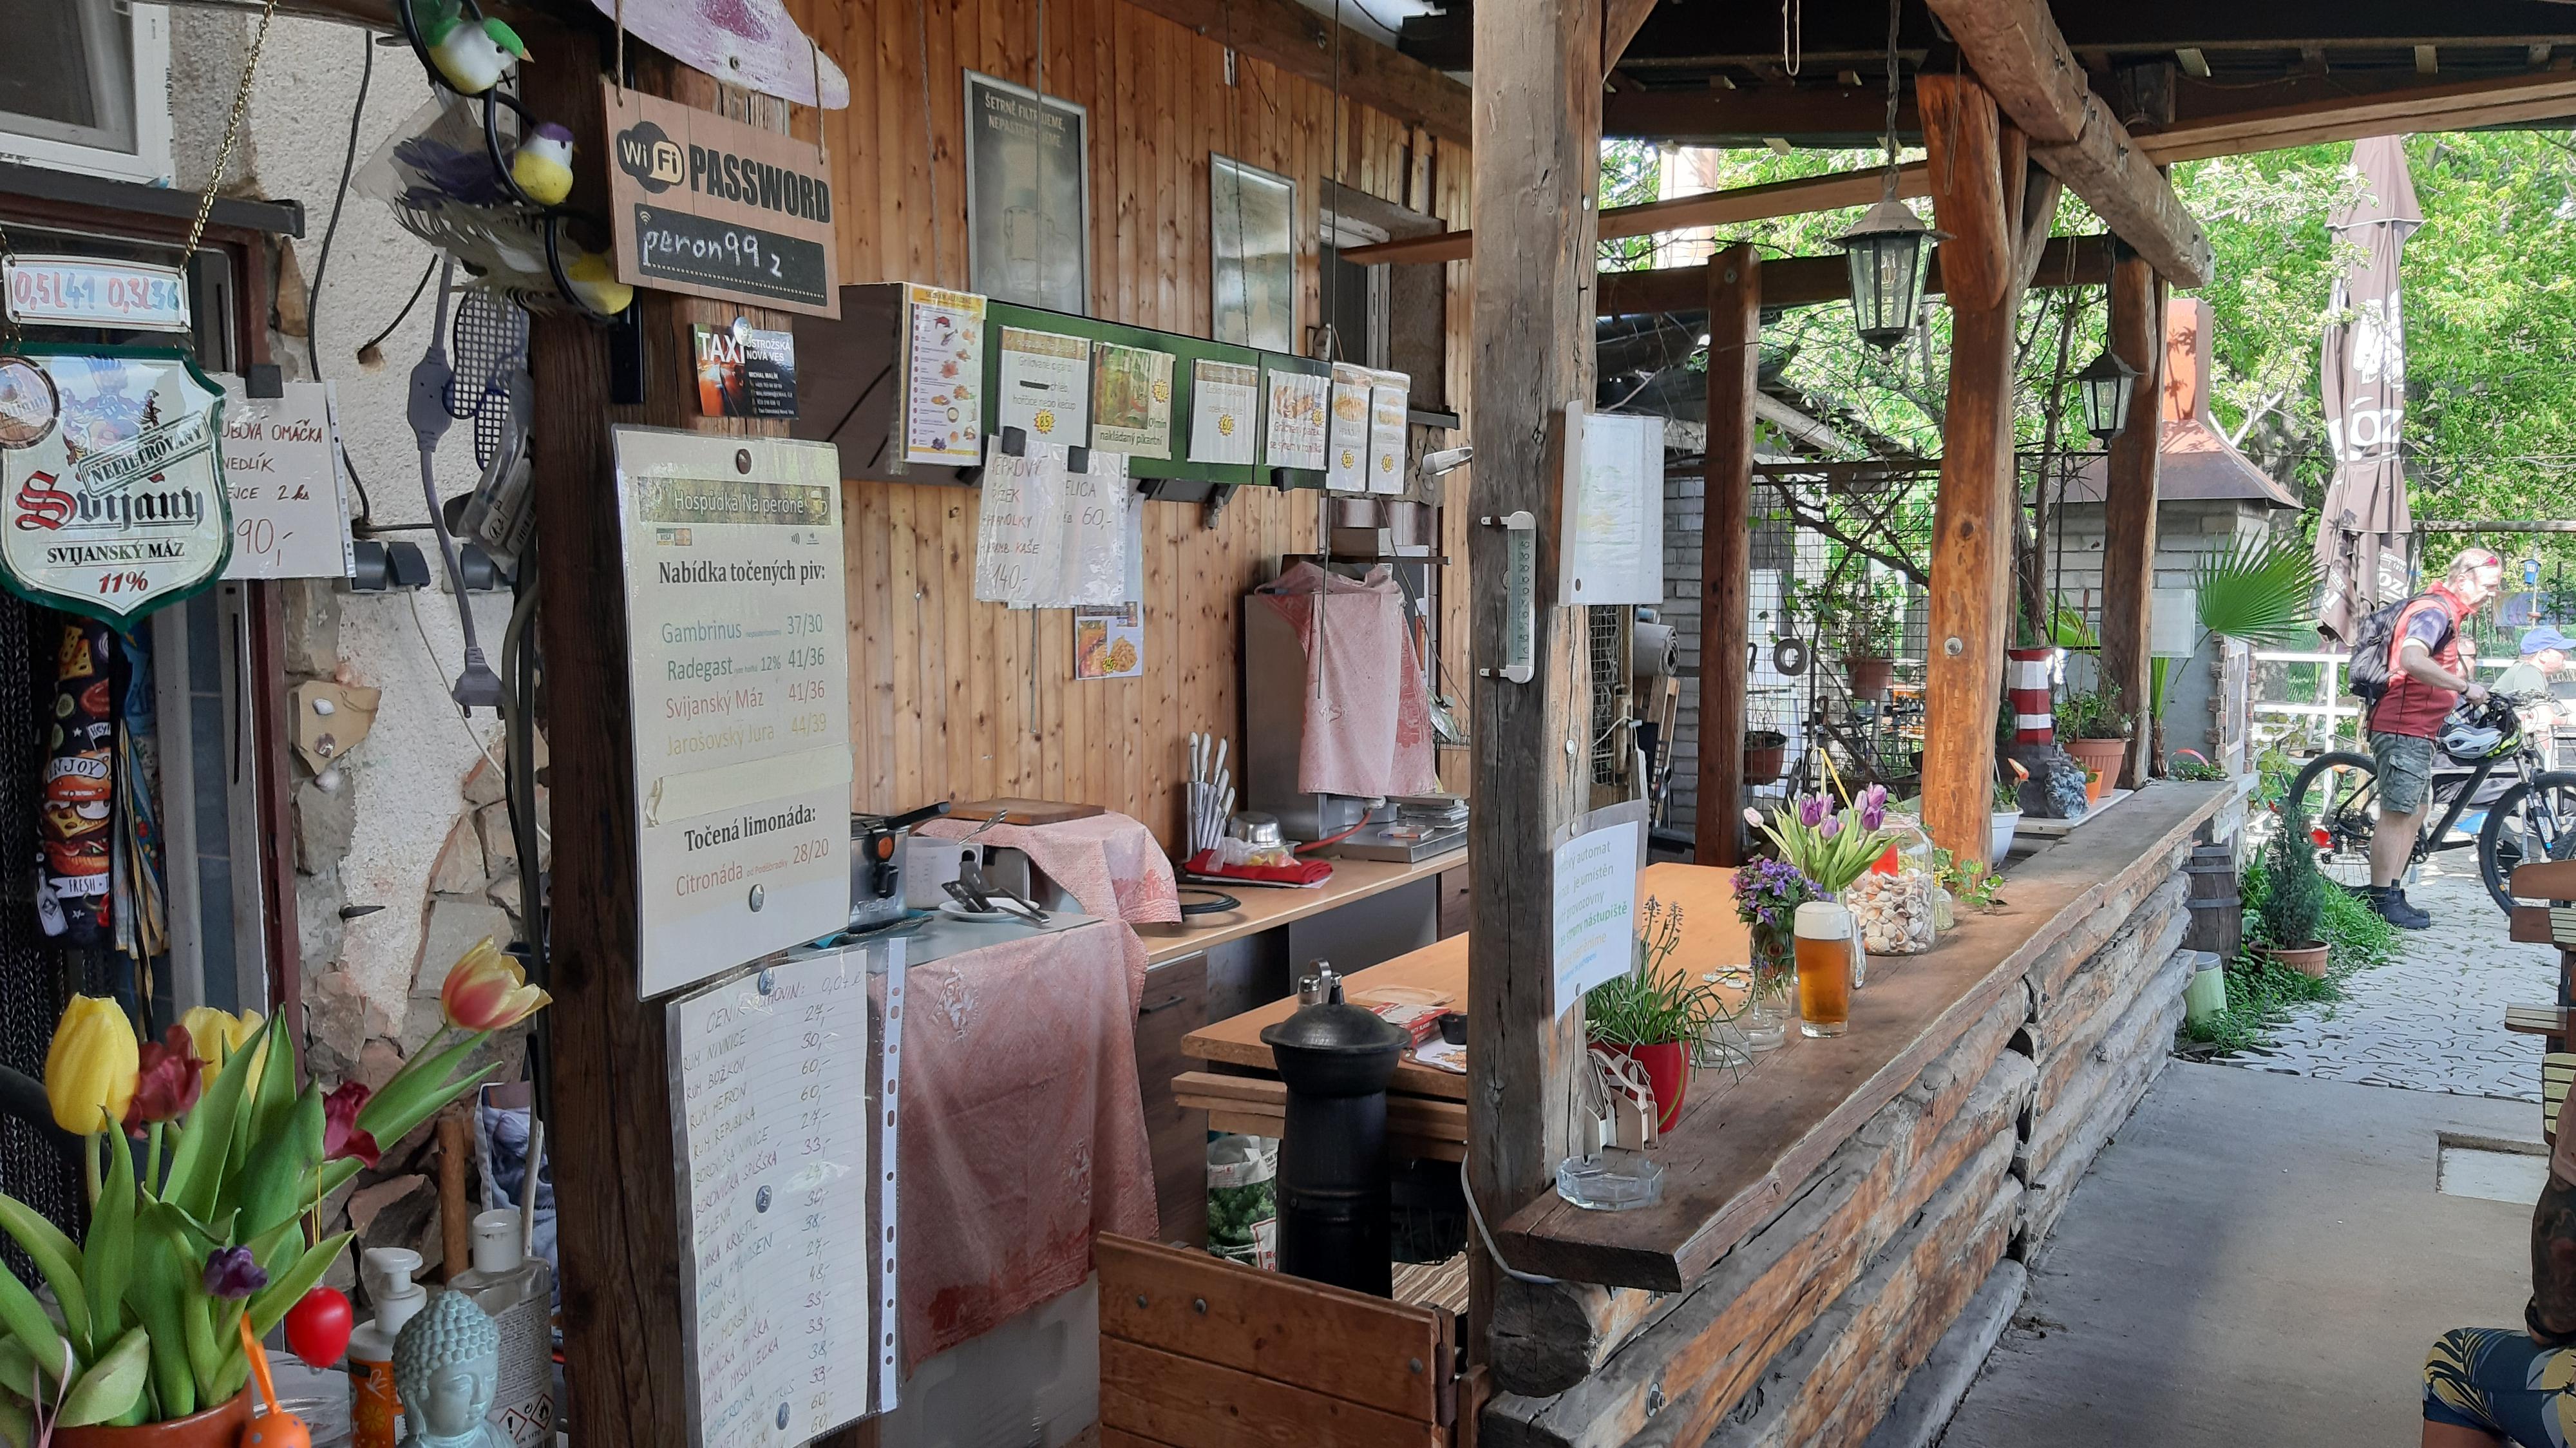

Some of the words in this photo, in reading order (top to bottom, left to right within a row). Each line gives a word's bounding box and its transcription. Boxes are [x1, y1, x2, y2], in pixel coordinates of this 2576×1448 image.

[985, 91, 1016, 116] ŠETRNĚ
[622, 138, 677, 175] WiFi
[688, 144, 831, 224] PASSWORD
[643, 230, 761, 267] peron99
[698, 332, 746, 364] TAXI
[746, 350, 768, 361] NOVÁ
[770, 351, 784, 362] VES
[271, 419, 323, 443] OMÁČKA
[15, 470, 204, 532] Svijany
[277, 485, 287, 501] 2
[674, 490, 739, 516] Hospůdka
[743, 493, 759, 513] Na
[46, 542, 142, 565] SVIJANSKÝ
[148, 540, 185, 558] MÁZ
[1016, 538, 1040, 555] KAŠE
[99, 569, 149, 595] 11%
[659, 560, 727, 584] Nabídka
[730, 559, 796, 586] točených
[800, 559, 826, 586] piv:
[662, 620, 742, 643] Gambrinus
[786, 613, 824, 638] 37/30
[668, 656, 733, 683] Radegast
[761, 655, 781, 672] 12%
[788, 647, 825, 671] 41/36
[666, 689, 732, 721] Svijanský
[735, 687, 764, 710] Máz
[788, 680, 825, 705] 41/36
[667, 723, 745, 757] Jarošovský
[748, 723, 775, 743] Jura
[791, 712, 827, 738] 44/39
[685, 818, 740, 852] Točená
[743, 804, 816, 839] limonáda:
[1577, 841, 1611, 864] automat
[676, 861, 743, 897] Citronáda
[793, 838, 829, 864] 28/20
[1573, 876, 1580, 893] je
[1581, 863, 1613, 886] umístěn
[68, 878, 96, 893] FRESH
[1584, 900, 1627, 928] nástupiště
